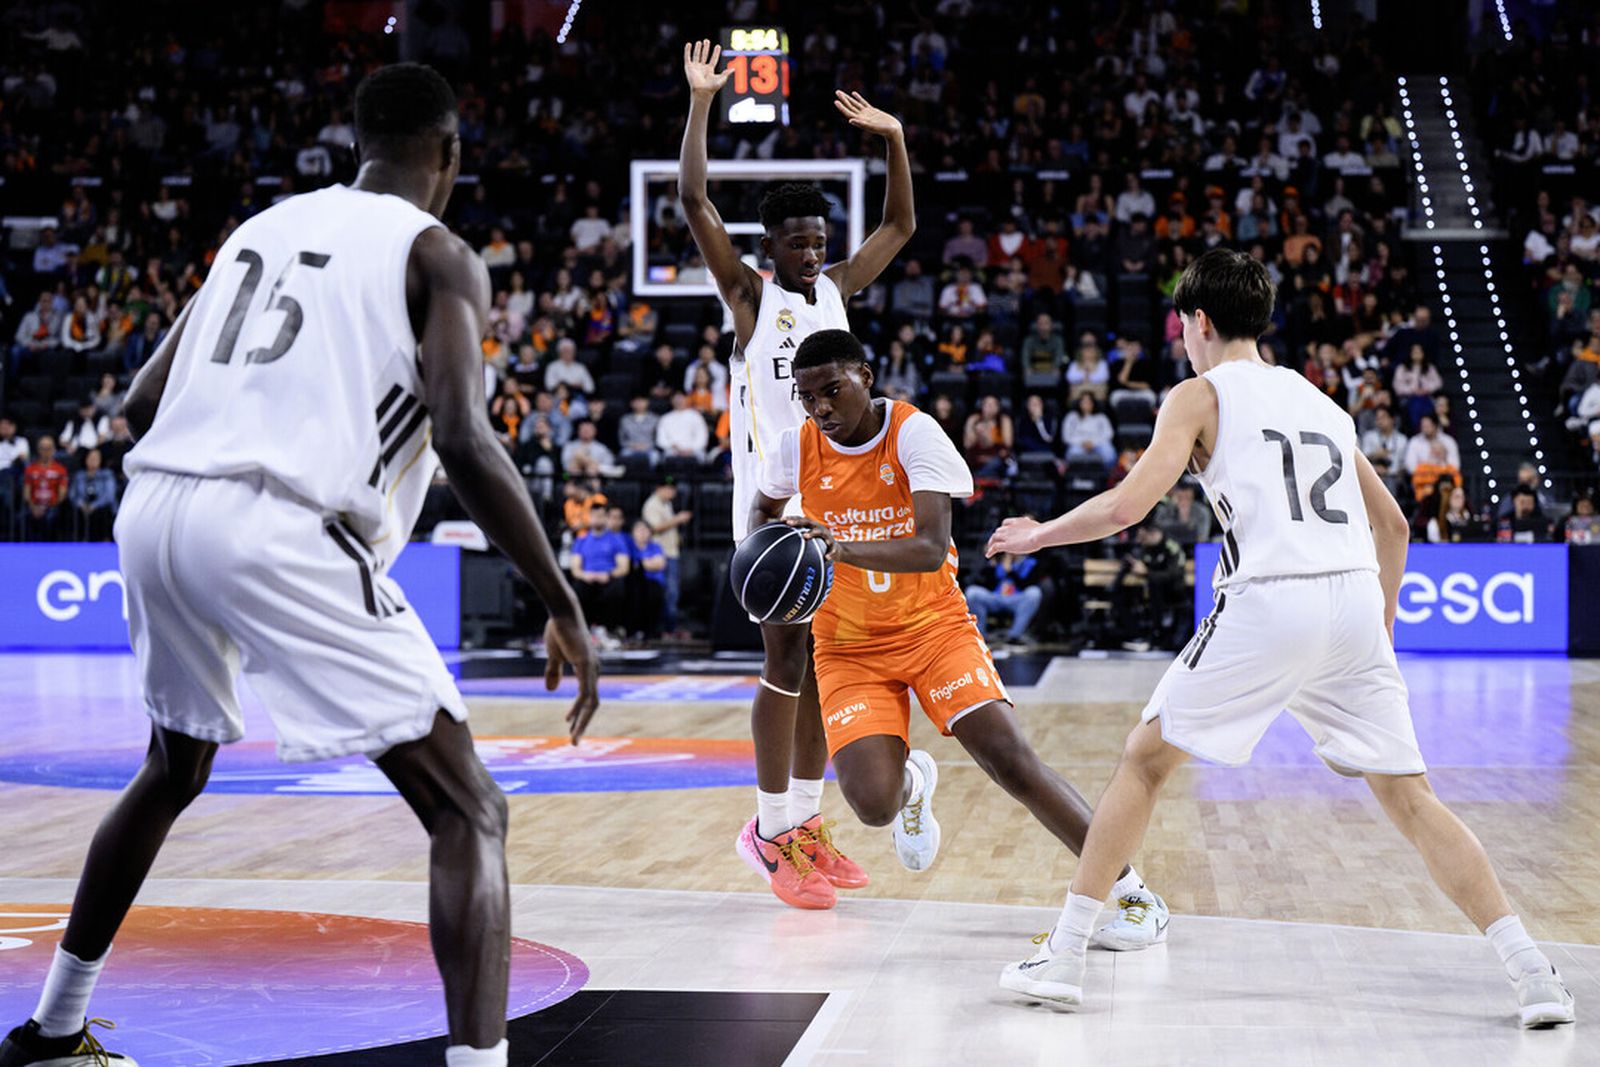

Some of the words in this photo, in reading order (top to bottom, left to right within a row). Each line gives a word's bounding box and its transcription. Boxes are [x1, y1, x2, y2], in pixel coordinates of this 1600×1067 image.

[727, 55, 779, 95] 13
[210, 248, 331, 366] 15
[1262, 429, 1348, 524] 12
[823, 506, 894, 526] Cultura
[830, 517, 915, 542] Esfuerzo
[929, 672, 974, 703] Frigicoll
[827, 702, 867, 727] PULEVA
